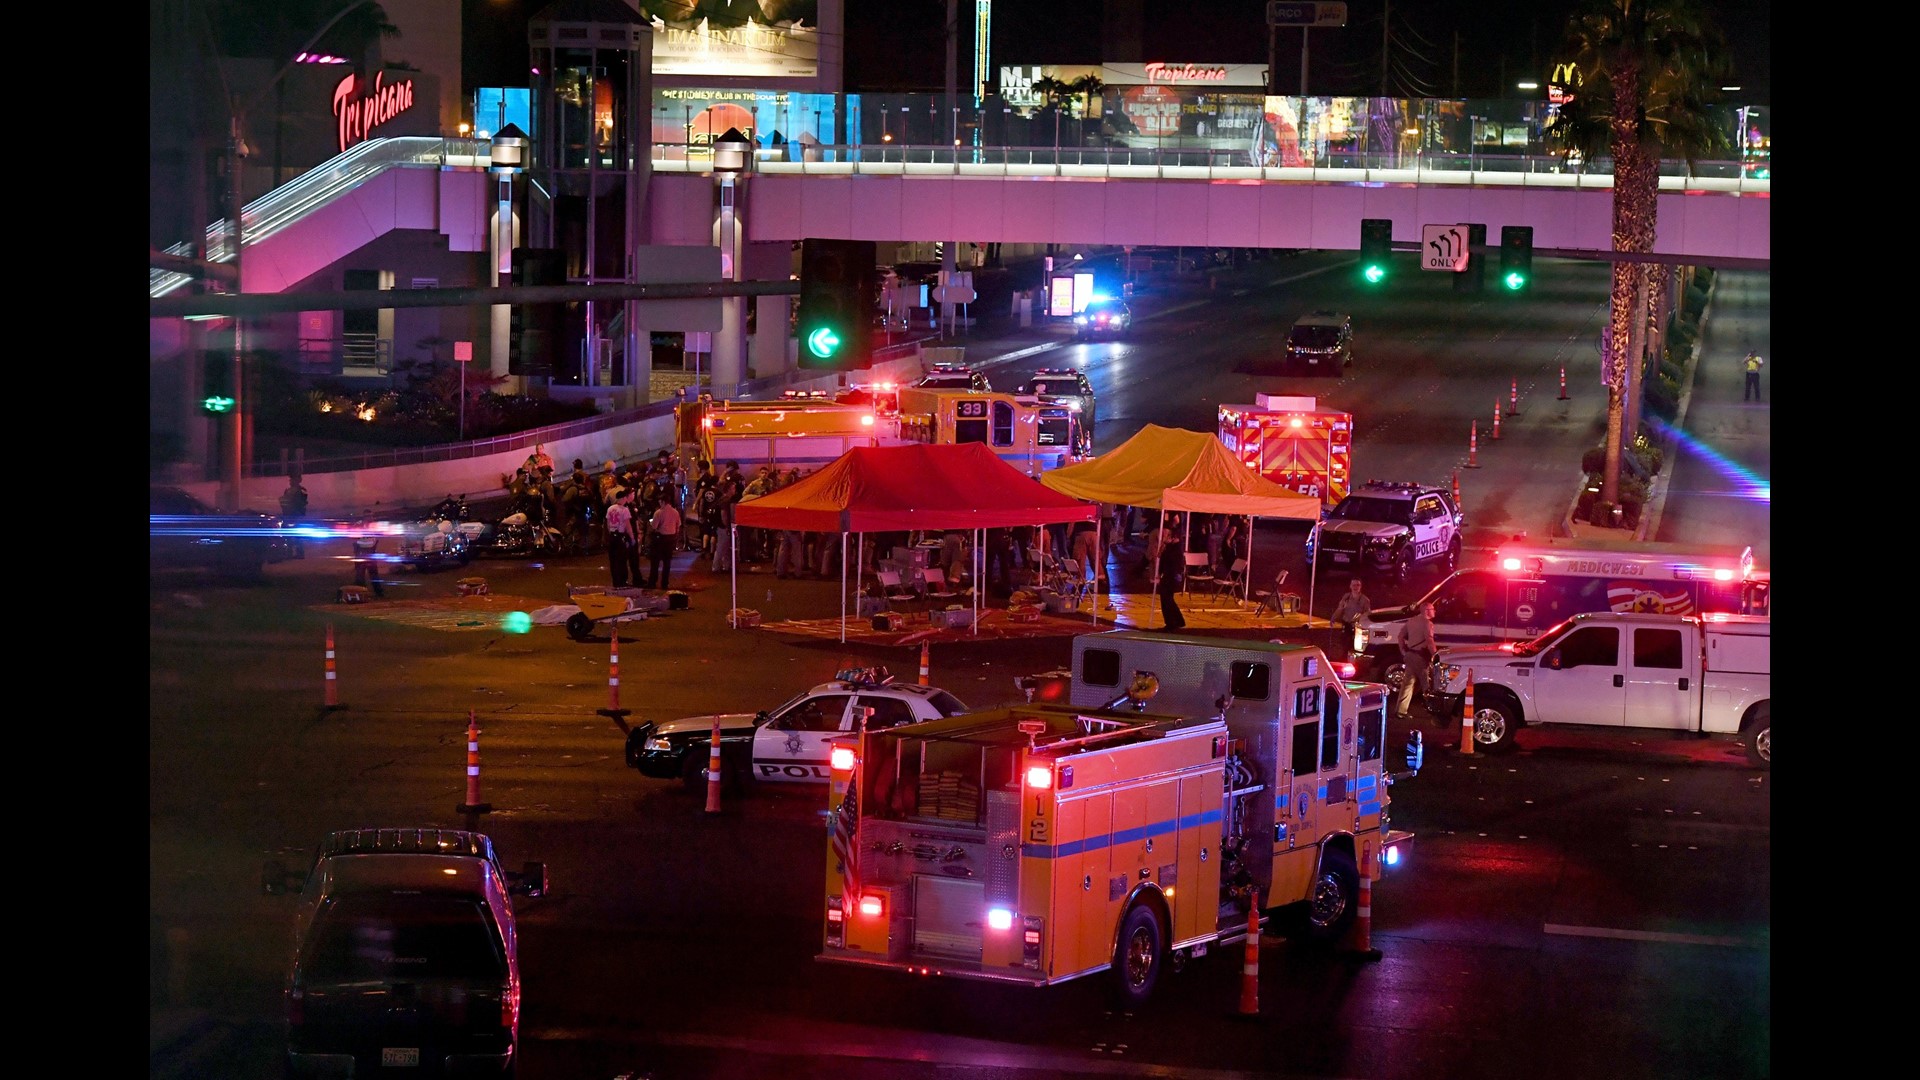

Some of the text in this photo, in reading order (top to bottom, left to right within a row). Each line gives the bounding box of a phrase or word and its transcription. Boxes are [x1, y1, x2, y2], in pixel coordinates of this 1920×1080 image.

[1145, 62, 1226, 85] Tropicana
[715, 91, 734, 100] CLUB
[734, 92, 742, 100] IN
[1430, 258, 1459, 268] ONLY
[962, 402, 982, 416] 33
[1416, 540, 1440, 558] POLICE
[1567, 559, 1647, 577] MEDICWEST
[1301, 689, 1314, 713] 12
